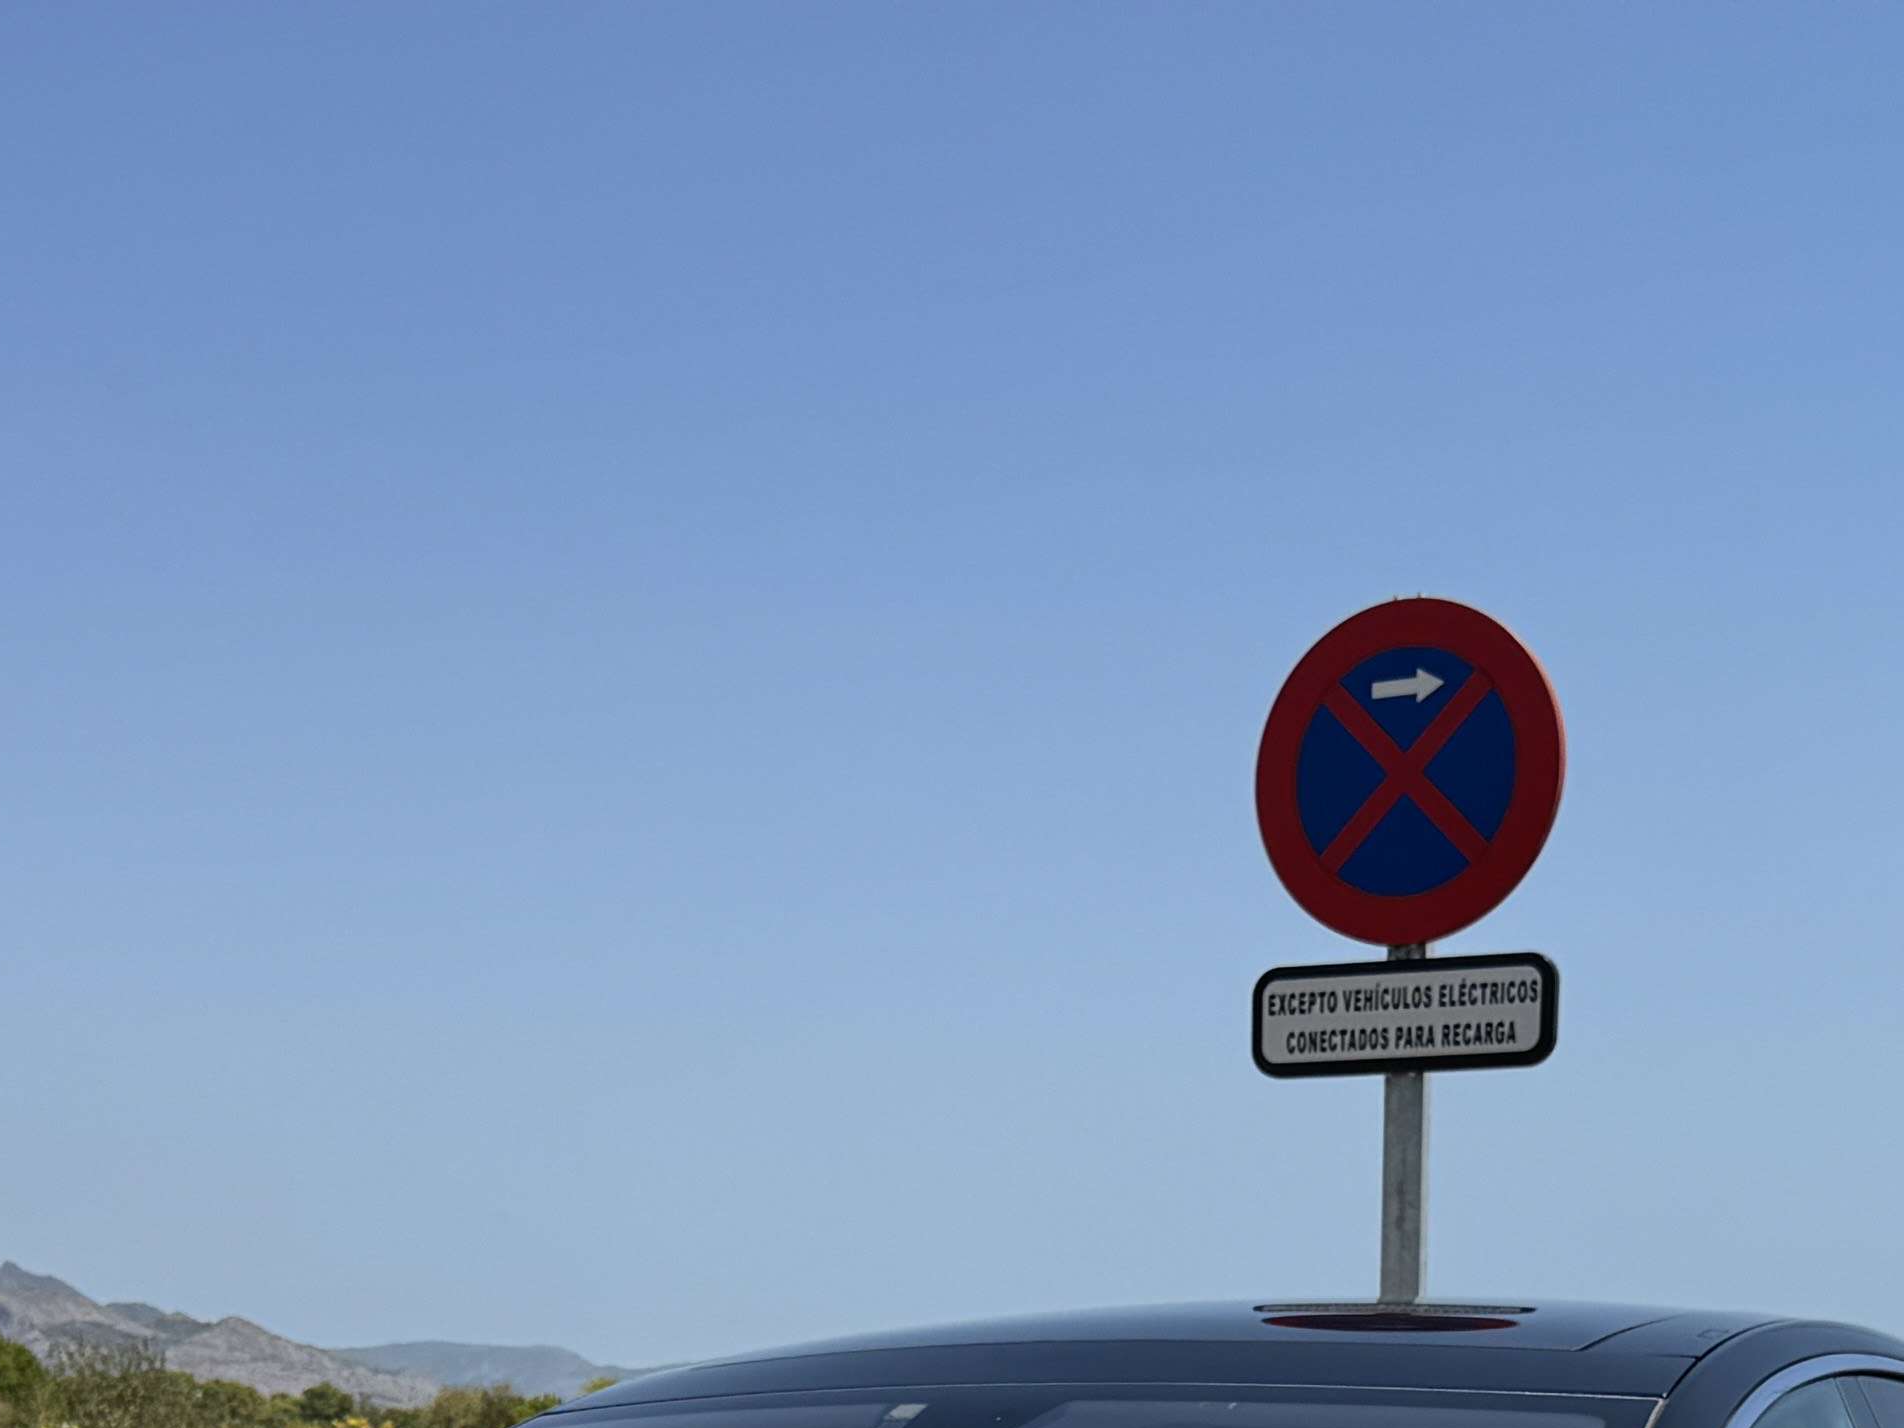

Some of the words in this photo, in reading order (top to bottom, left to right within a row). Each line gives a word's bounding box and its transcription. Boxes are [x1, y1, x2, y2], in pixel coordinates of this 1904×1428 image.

[1267, 989, 1338, 1017] EXCEPTO
[1342, 982, 1432, 1013] VEHÍCULOS
[1437, 978, 1539, 1008] ELÉCTRICOS
[1285, 1026, 1389, 1054] CONECTADOS
[1394, 1024, 1435, 1048] PARA
[1441, 1019, 1517, 1046] RECARGA
